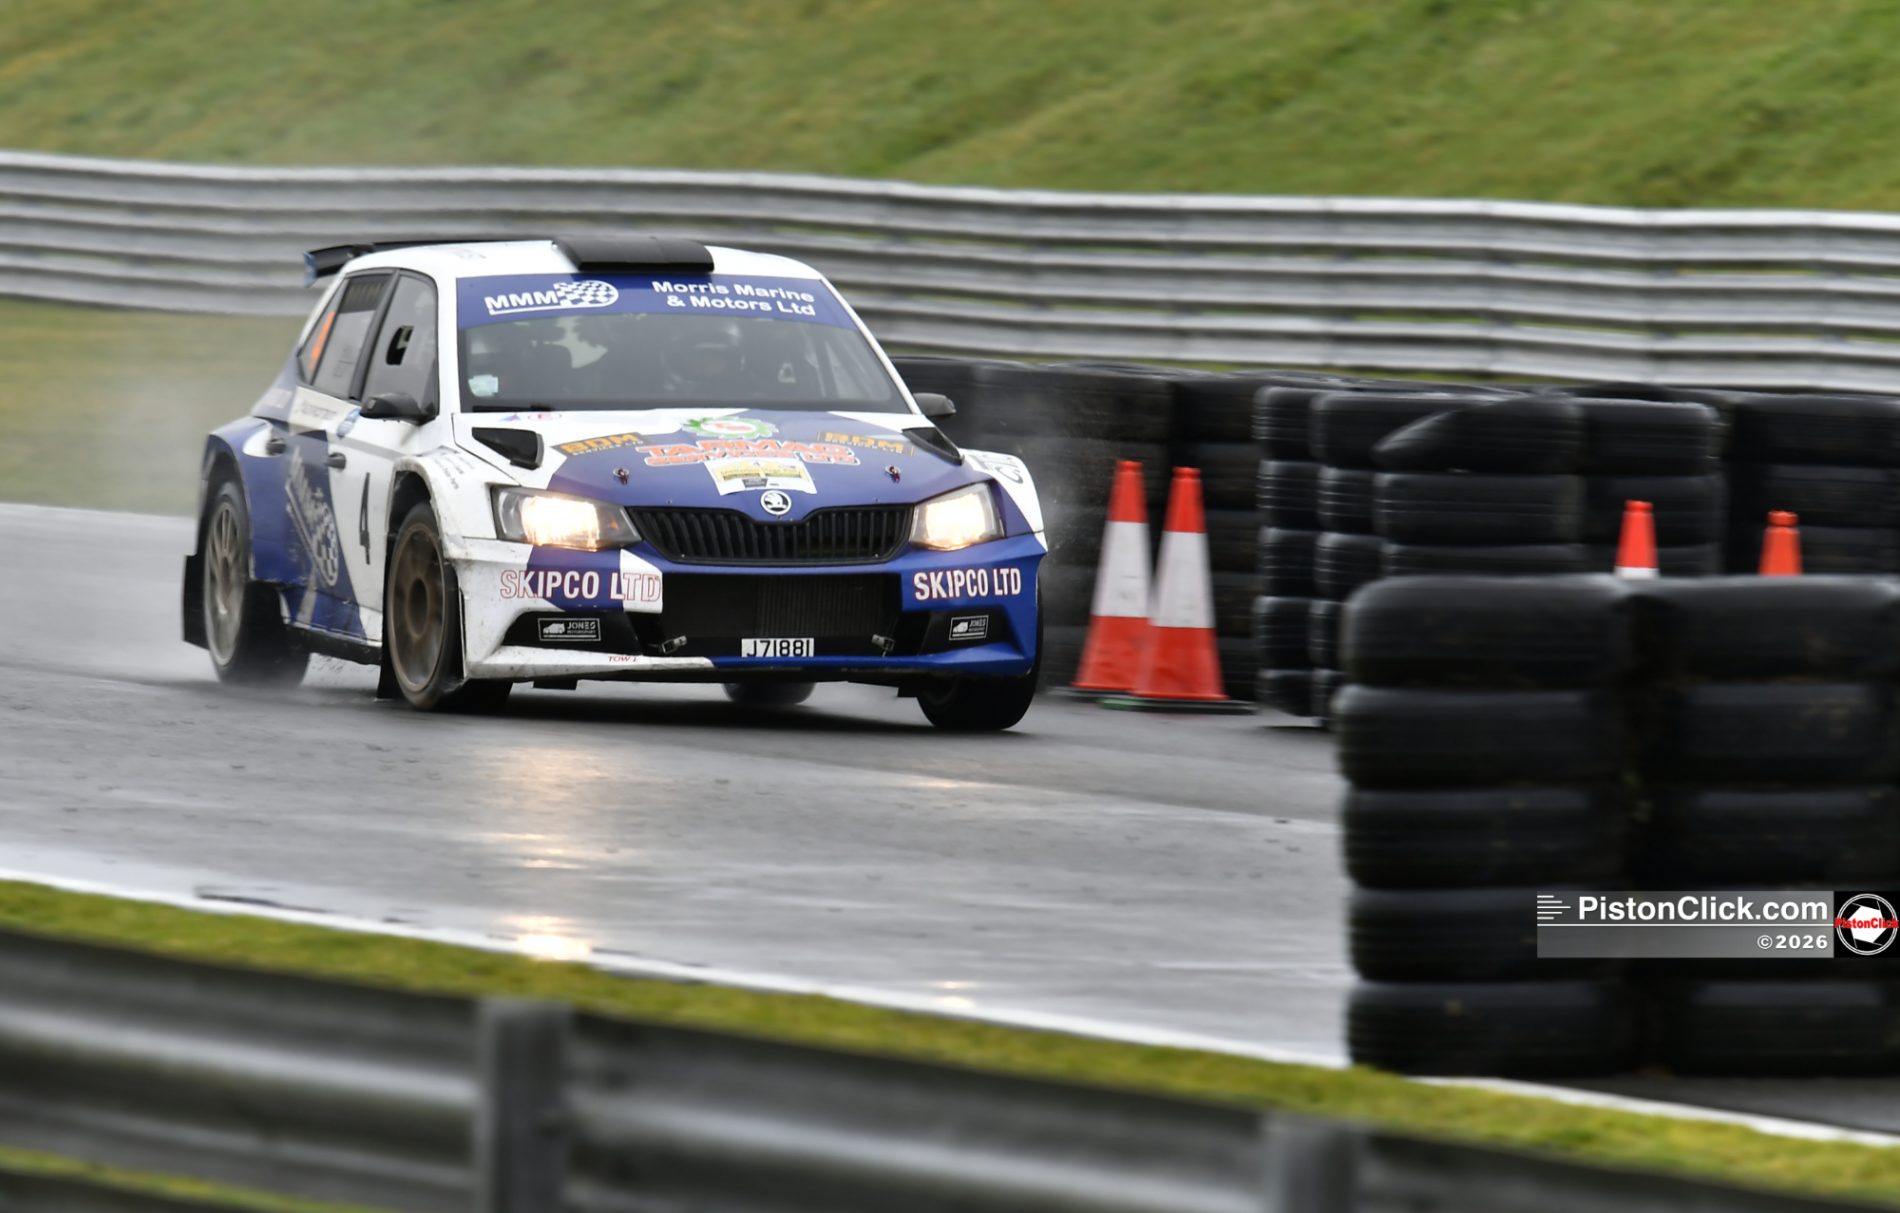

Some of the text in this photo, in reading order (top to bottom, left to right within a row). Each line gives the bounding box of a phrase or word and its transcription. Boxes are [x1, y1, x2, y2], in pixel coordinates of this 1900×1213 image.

[484, 291, 559, 309] MMM
[652, 281, 815, 302] Morris Marine
[667, 295, 816, 316] & Motors Ltd
[359, 472, 371, 565] 4
[500, 570, 662, 601] SKIPCO LTD
[913, 568, 1022, 600] SKIPCO LTD
[567, 621, 596, 630] JONES
[746, 639, 814, 657] J71881
